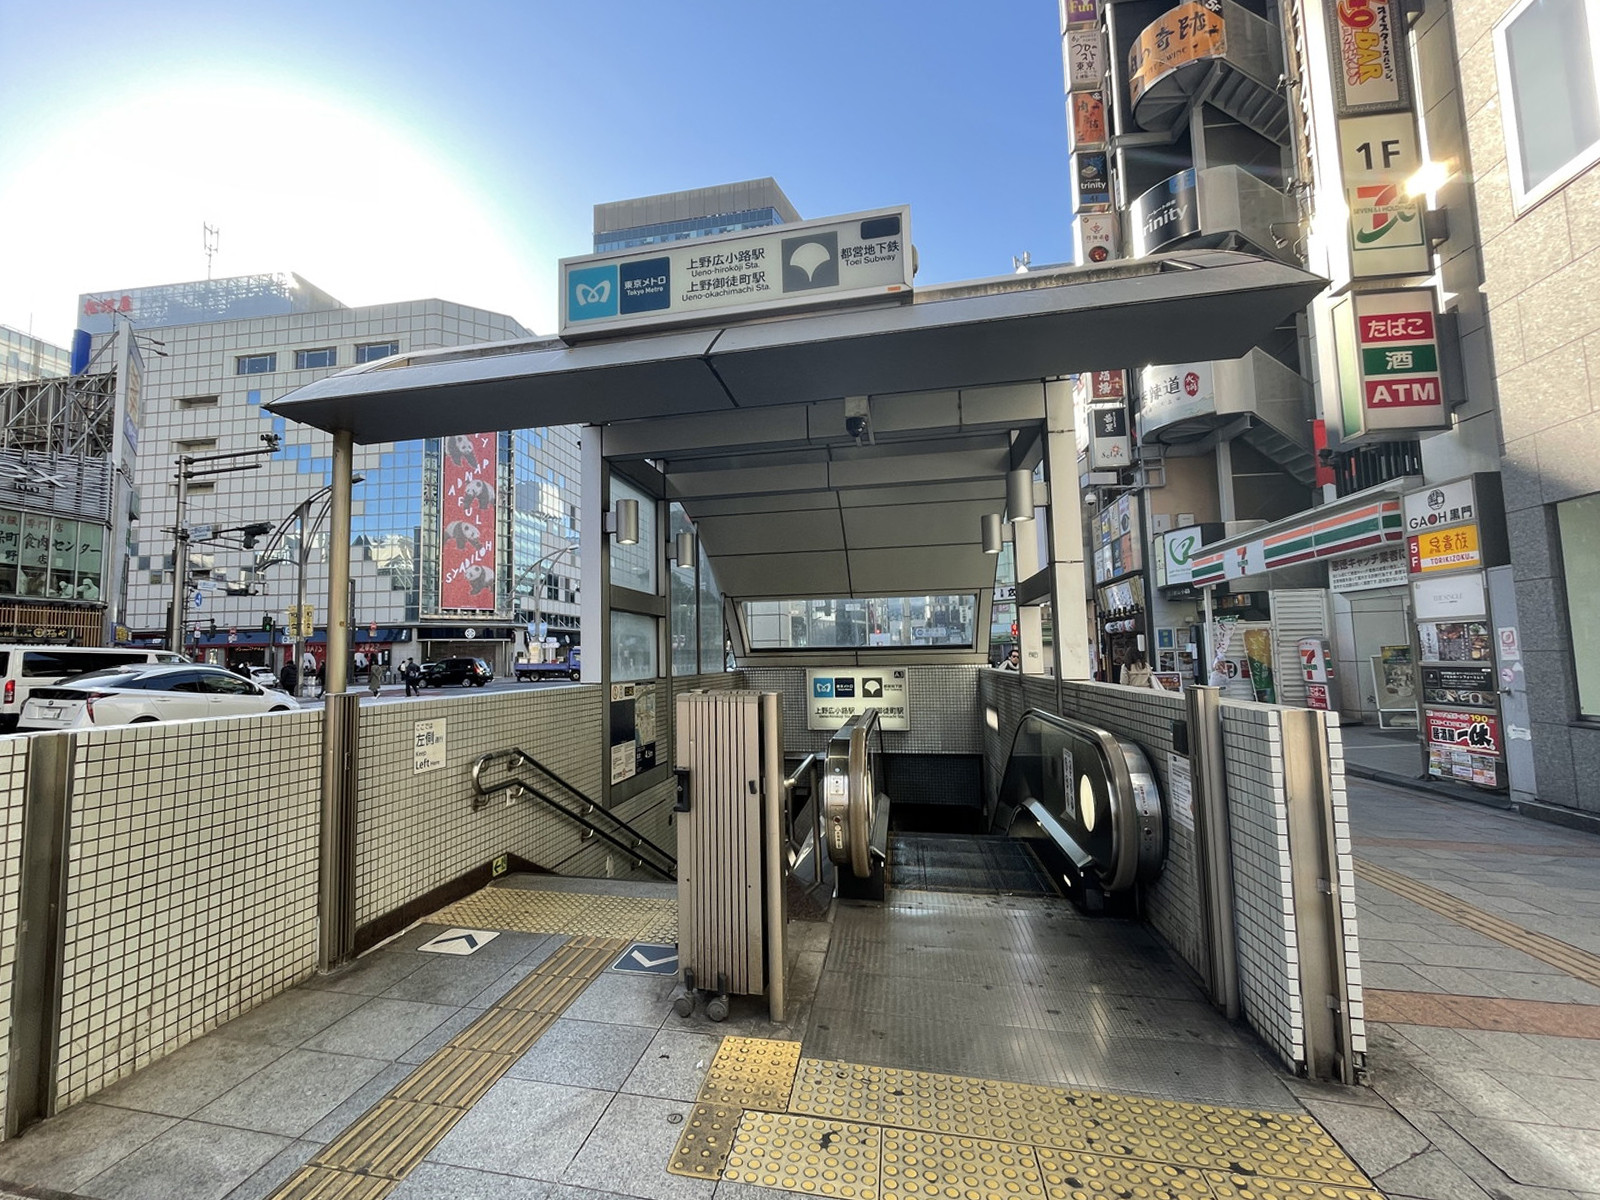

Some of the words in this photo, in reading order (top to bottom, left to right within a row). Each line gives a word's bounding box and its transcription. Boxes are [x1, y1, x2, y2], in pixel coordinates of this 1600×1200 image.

[1356, 139, 1400, 170] 1F
[1080, 180, 1107, 190] trinity
[1143, 204, 1188, 236] rinity
[686, 247, 765, 270] 上野広小路駅
[841, 240, 900, 260] 都営地下鉄
[845, 258, 862, 267] Toei
[863, 253, 896, 265] Subway
[744, 261, 759, 270] Sta.
[624, 275, 667, 290] 東京メトロ
[626, 287, 645, 297] Tokyo
[645, 285, 664, 294] Metro
[686, 271, 766, 293] 上野御徒町駅
[681, 286, 754, 302] Ueno-okachimachi
[755, 283, 771, 292] Sta.
[1367, 317, 1426, 338] たばこ
[1385, 350, 1413, 370] 酒
[1372, 382, 1435, 403] ATM
[1430, 553, 1471, 565] TORIKIZOKU
